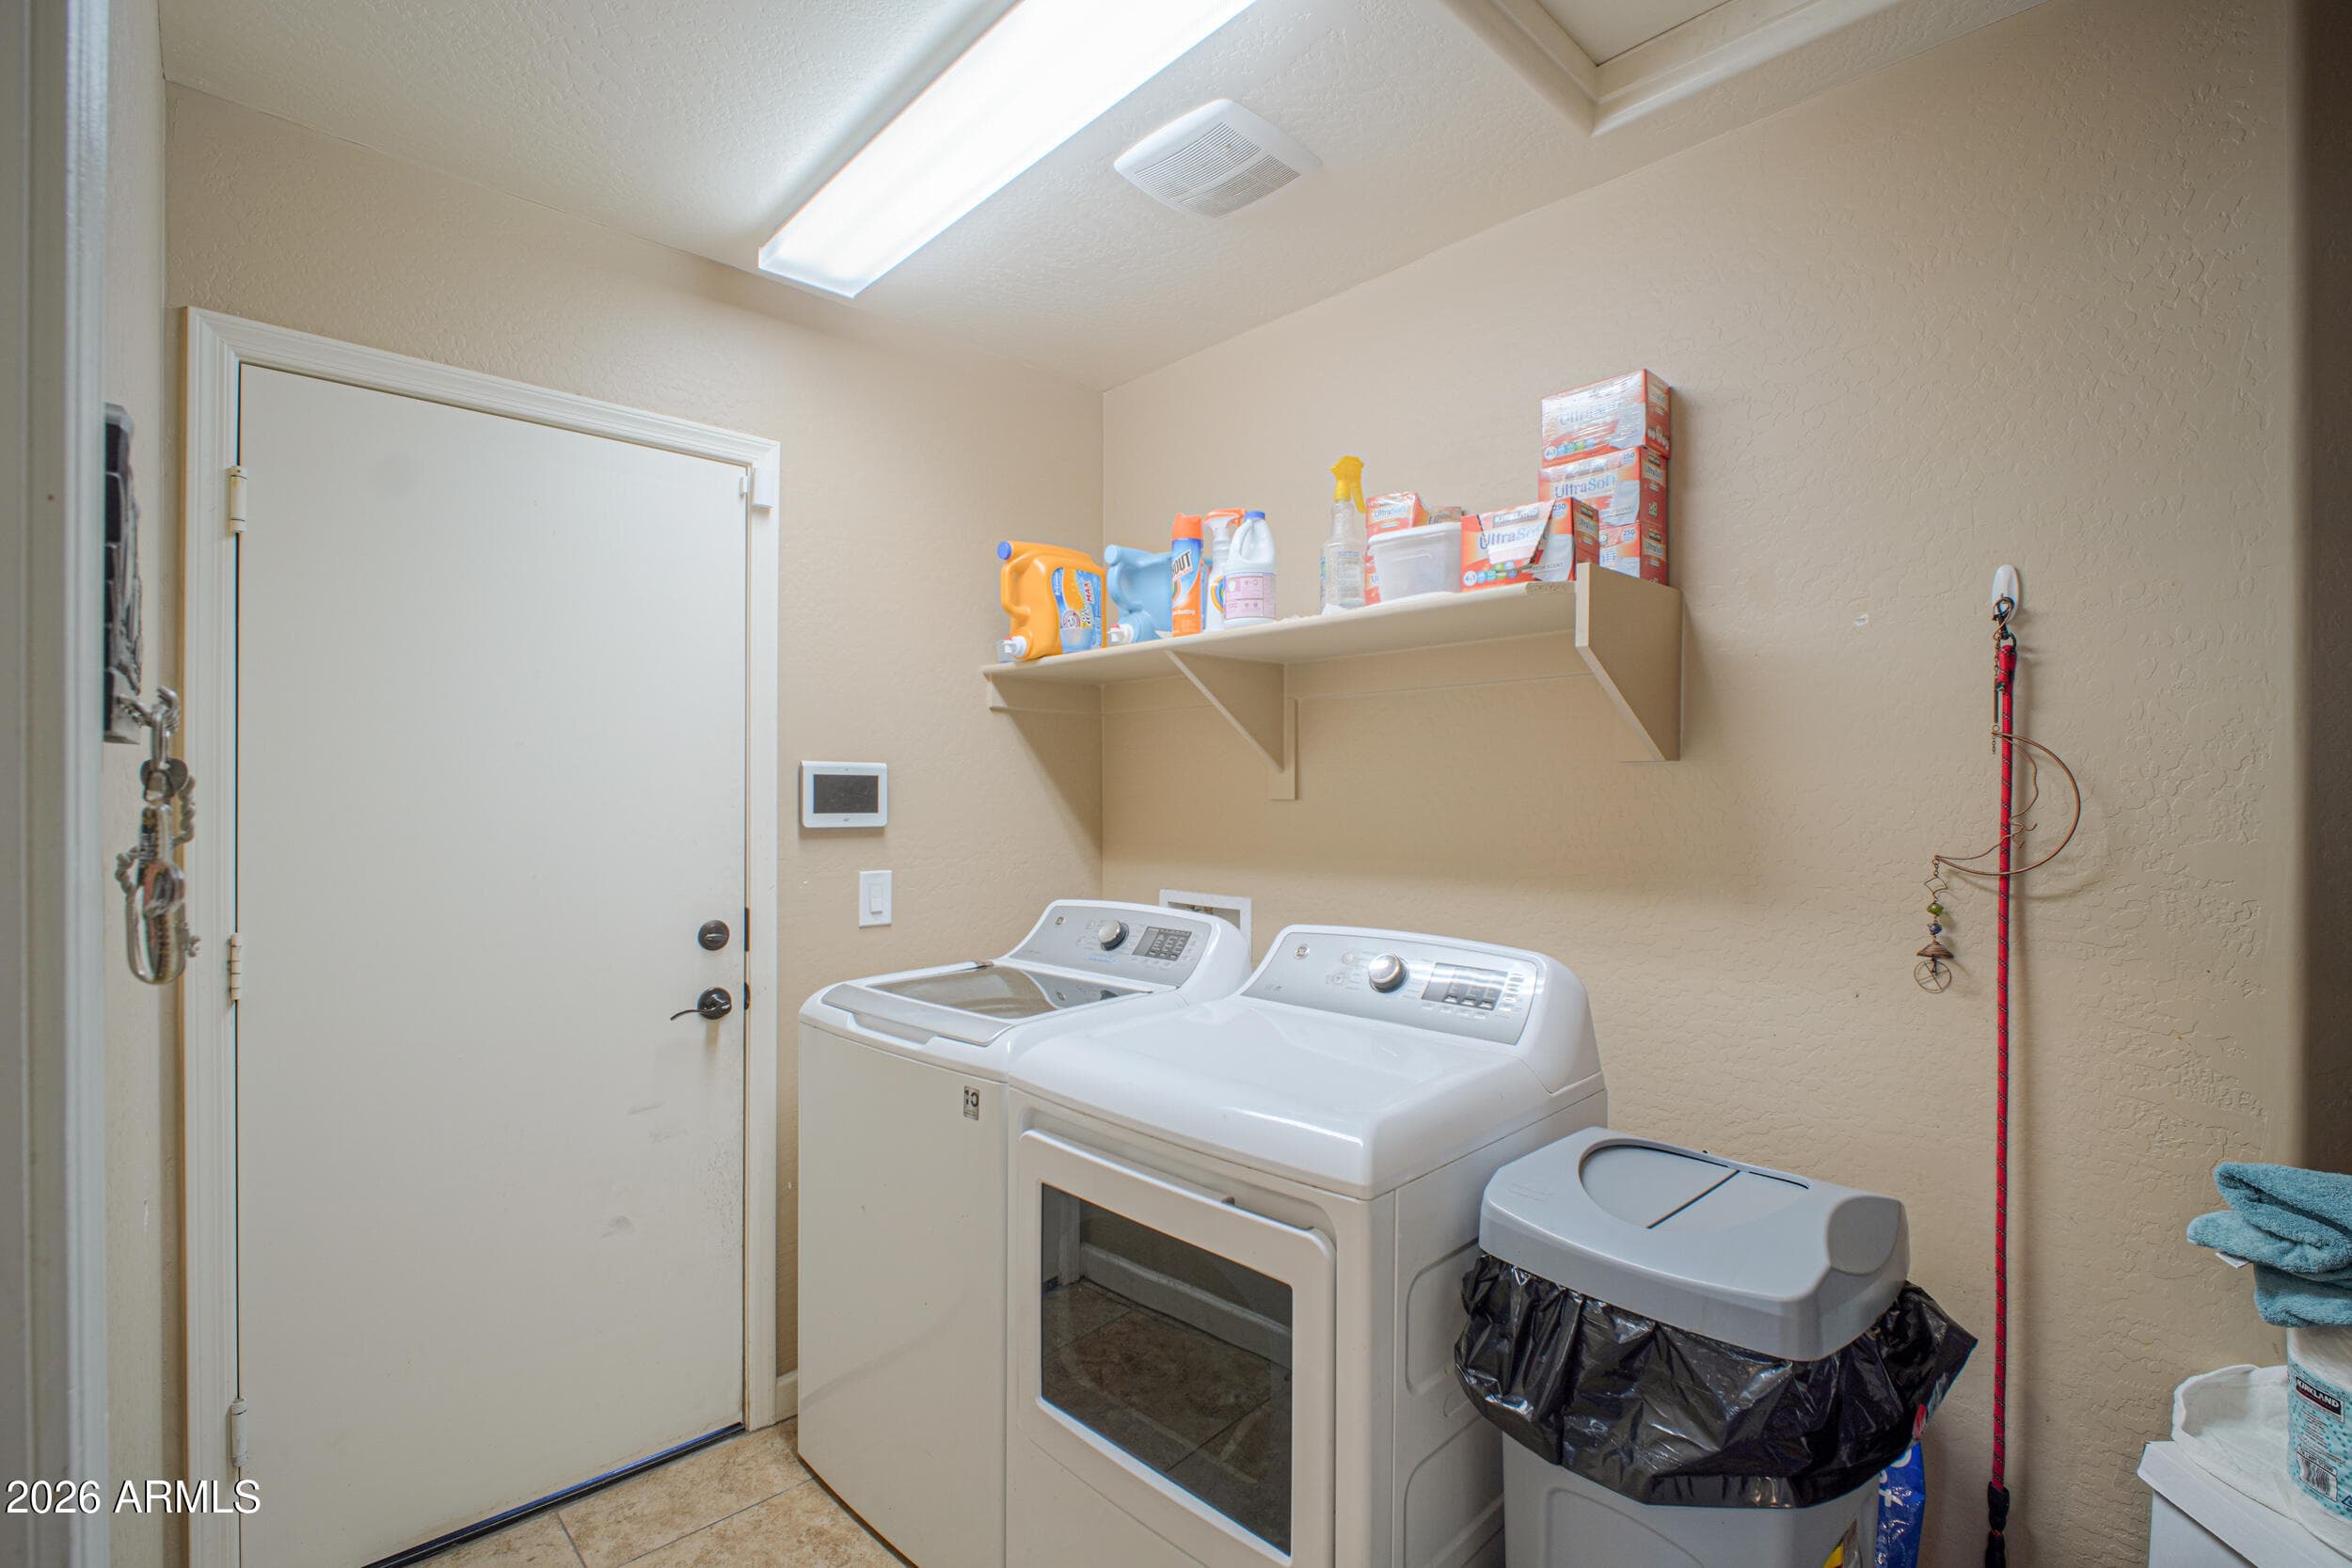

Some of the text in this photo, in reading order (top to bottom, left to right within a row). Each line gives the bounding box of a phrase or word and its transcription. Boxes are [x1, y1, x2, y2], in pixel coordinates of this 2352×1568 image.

[1623, 451, 1635, 461] 250
[1555, 474, 1616, 499] UltraSoft
[2296, 1379, 2340, 1408] KIRKLAND
